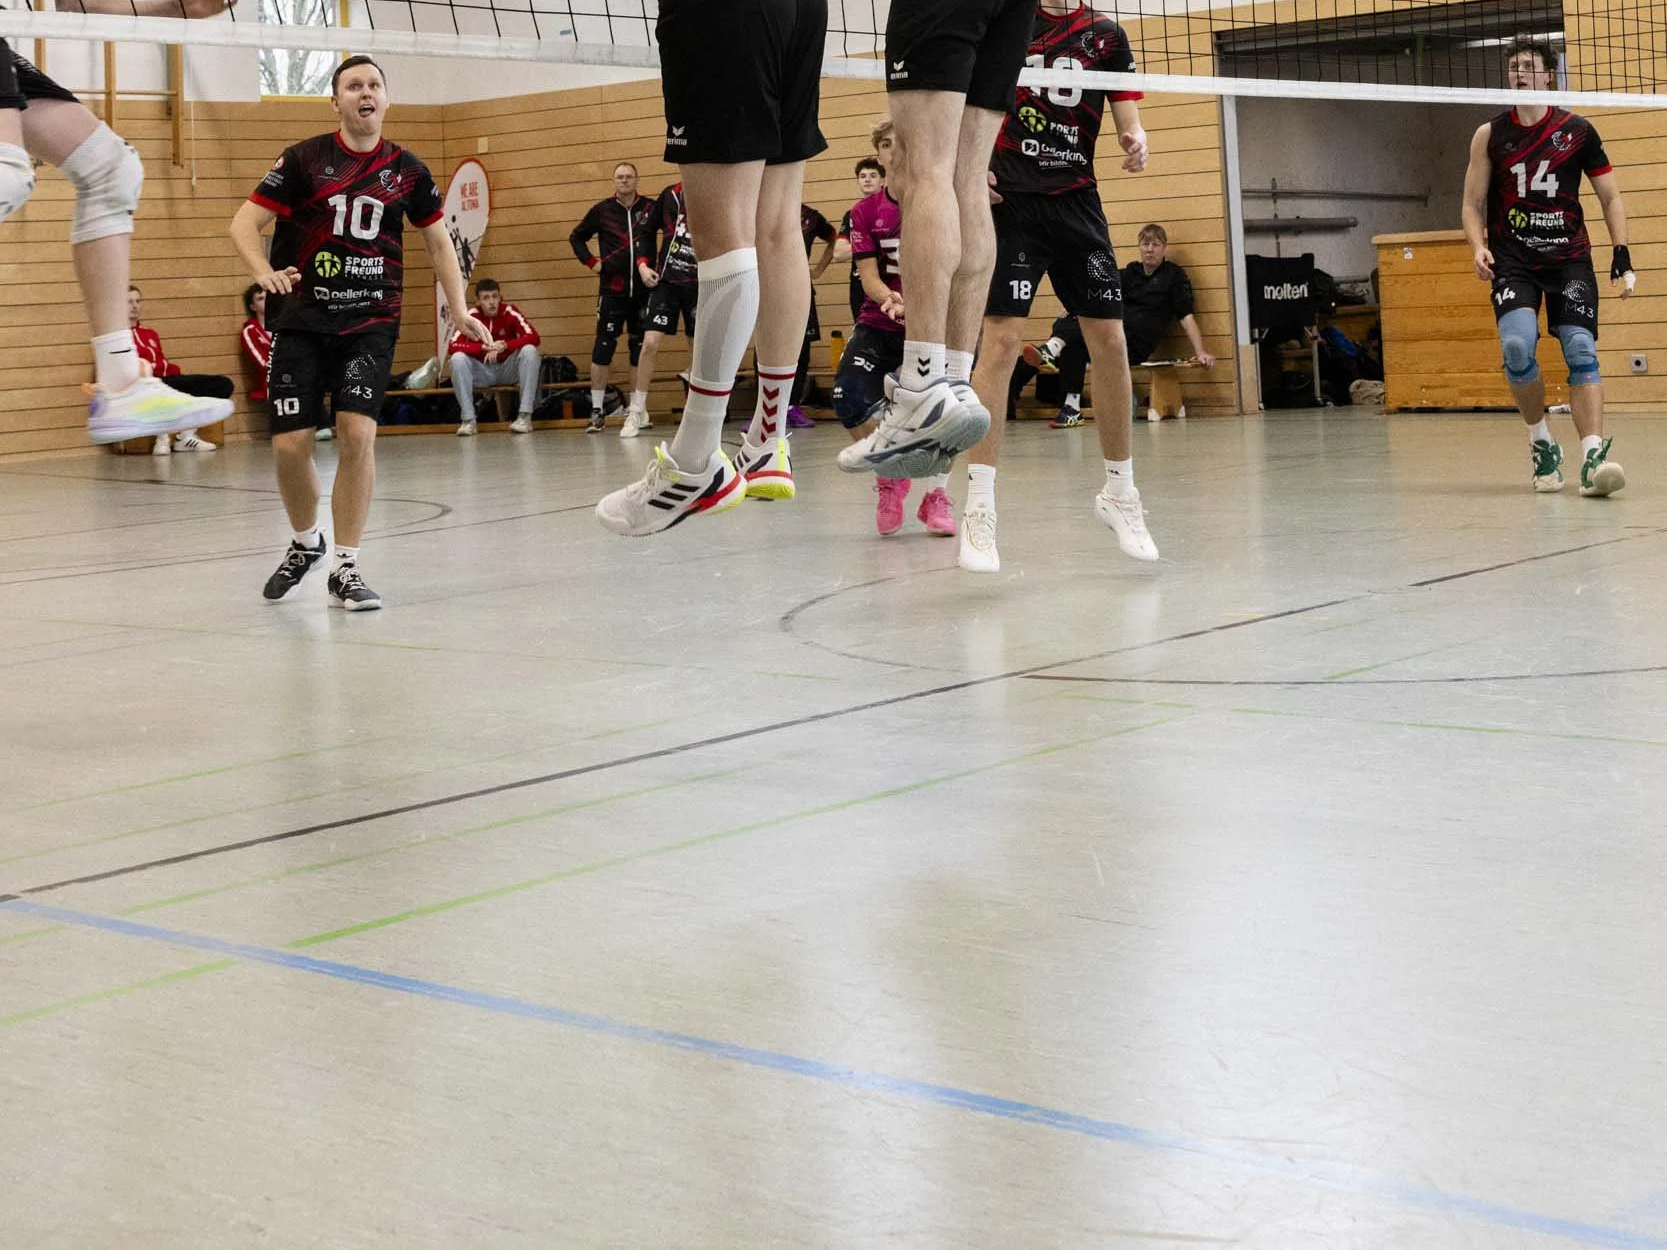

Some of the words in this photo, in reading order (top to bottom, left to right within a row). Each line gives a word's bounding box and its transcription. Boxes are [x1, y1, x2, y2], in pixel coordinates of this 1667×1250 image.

[1510, 160, 1559, 198] 14
[328, 194, 385, 240] 10
[344, 265, 384, 275] FREUND
[345, 256, 384, 267] SPORTS
[1009, 280, 1032, 300] 18
[1087, 289, 1123, 301] M43
[1263, 283, 1308, 300] molten
[1495, 287, 1516, 306] 14
[1564, 301, 1595, 318] M43
[607, 322, 615, 332] 5
[653, 314, 669, 326] 43
[274, 398, 300, 417] 10
